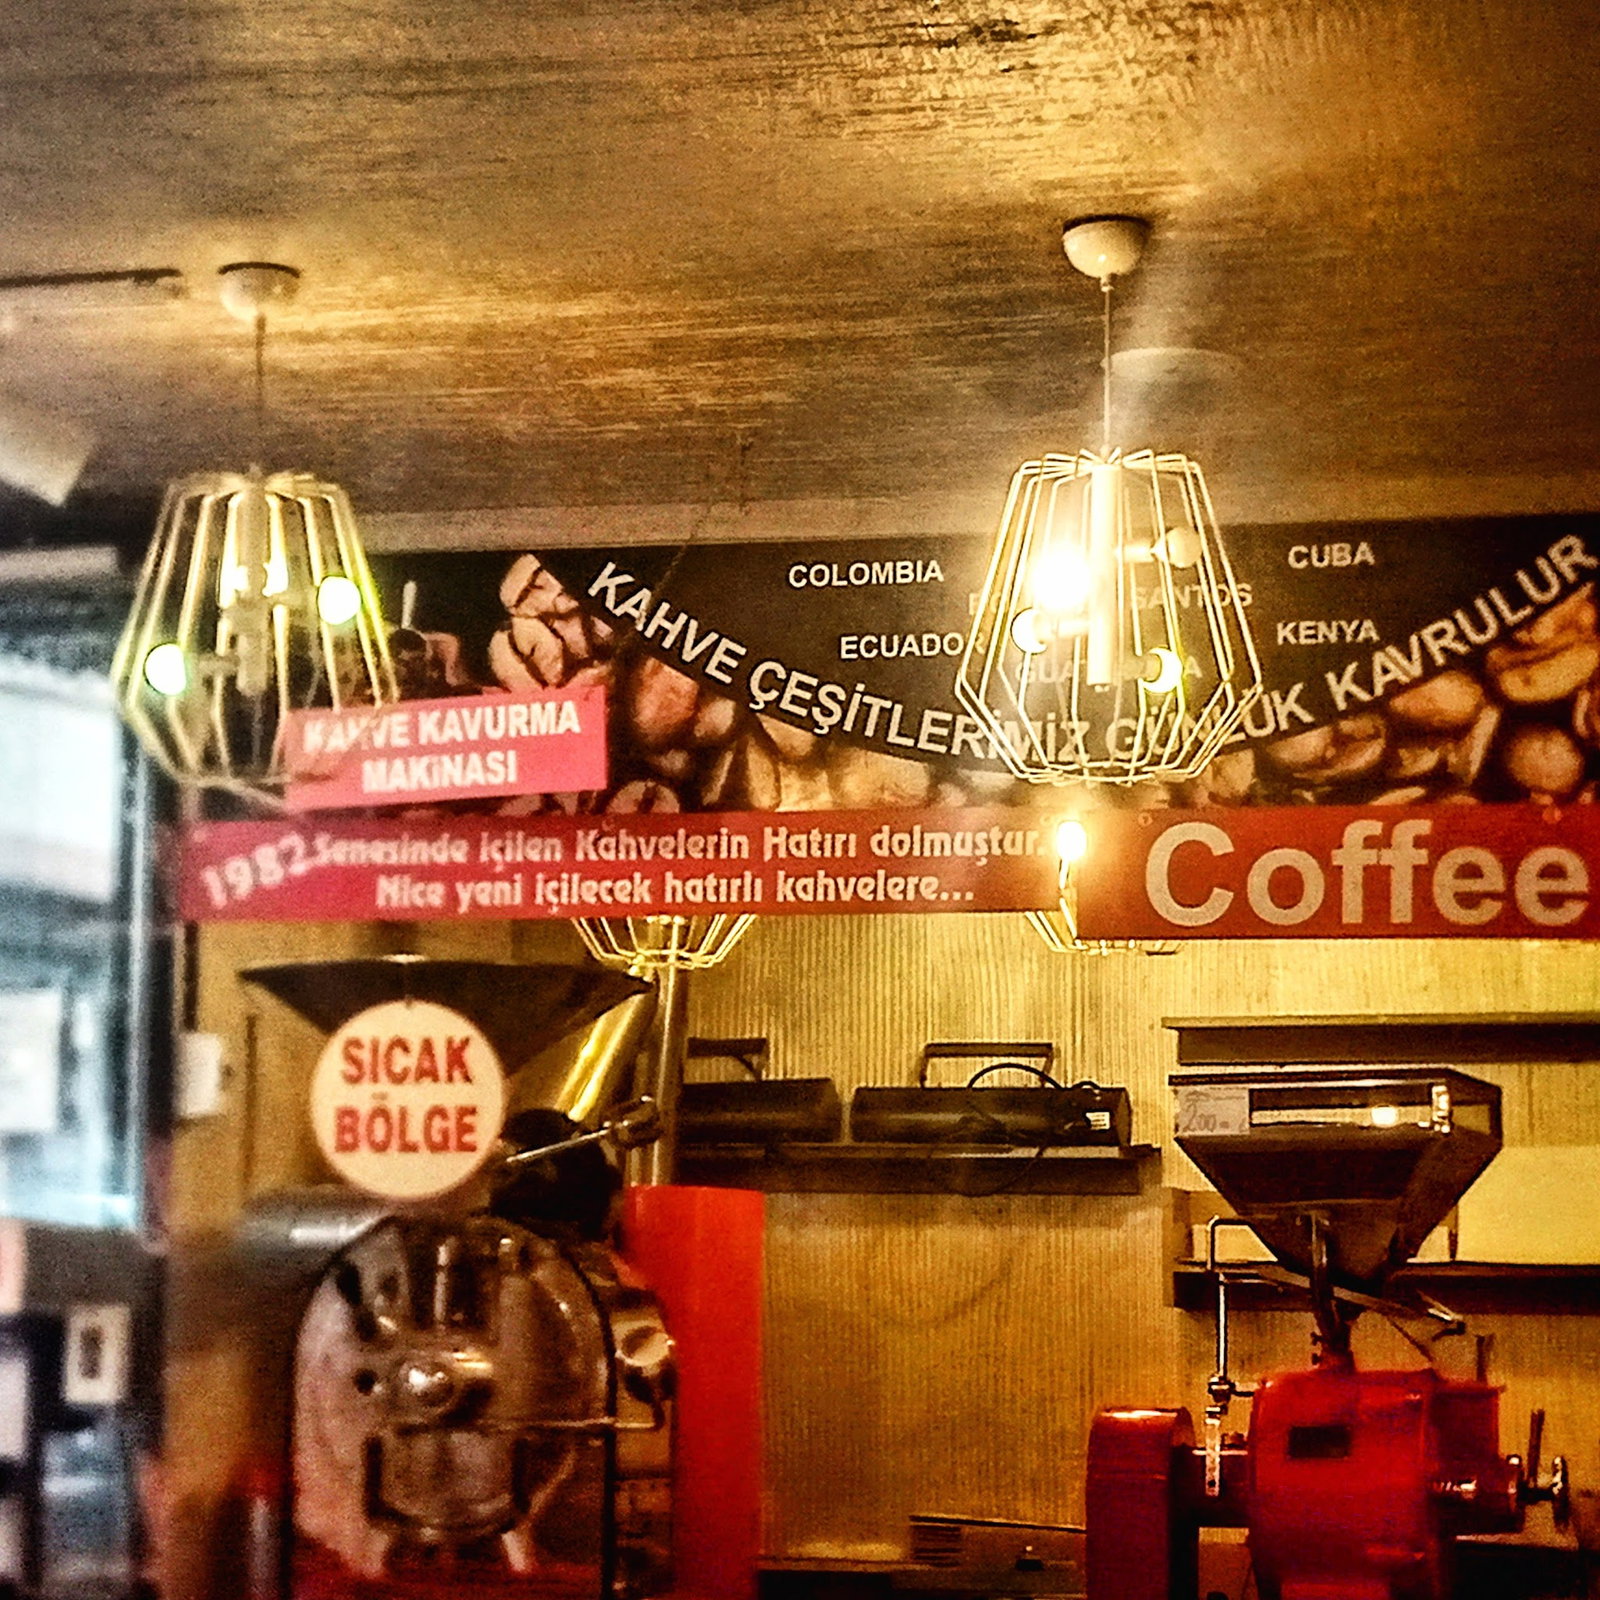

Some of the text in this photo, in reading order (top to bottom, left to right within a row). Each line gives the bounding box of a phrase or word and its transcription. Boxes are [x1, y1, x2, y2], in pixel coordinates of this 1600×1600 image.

[788, 560, 945, 588] COLOMBIA
[1287, 542, 1376, 569] CUBA
[588, 561, 746, 684] KAHVE
[1325, 534, 1600, 711] KAVRULUR
[1276, 619, 1380, 646] KENYA
[303, 701, 581, 754] KAHVE KAVURMA
[575, 828, 749, 862] Kahvelerin
[763, 826, 856, 862] Hatırı
[375, 873, 445, 908] Nice
[455, 873, 524, 914] yeni
[664, 870, 763, 904] hatırlı
[1145, 819, 1590, 927] Coffee
[342, 1034, 473, 1086] SICAK
[334, 1092, 479, 1154] BÖLGE
